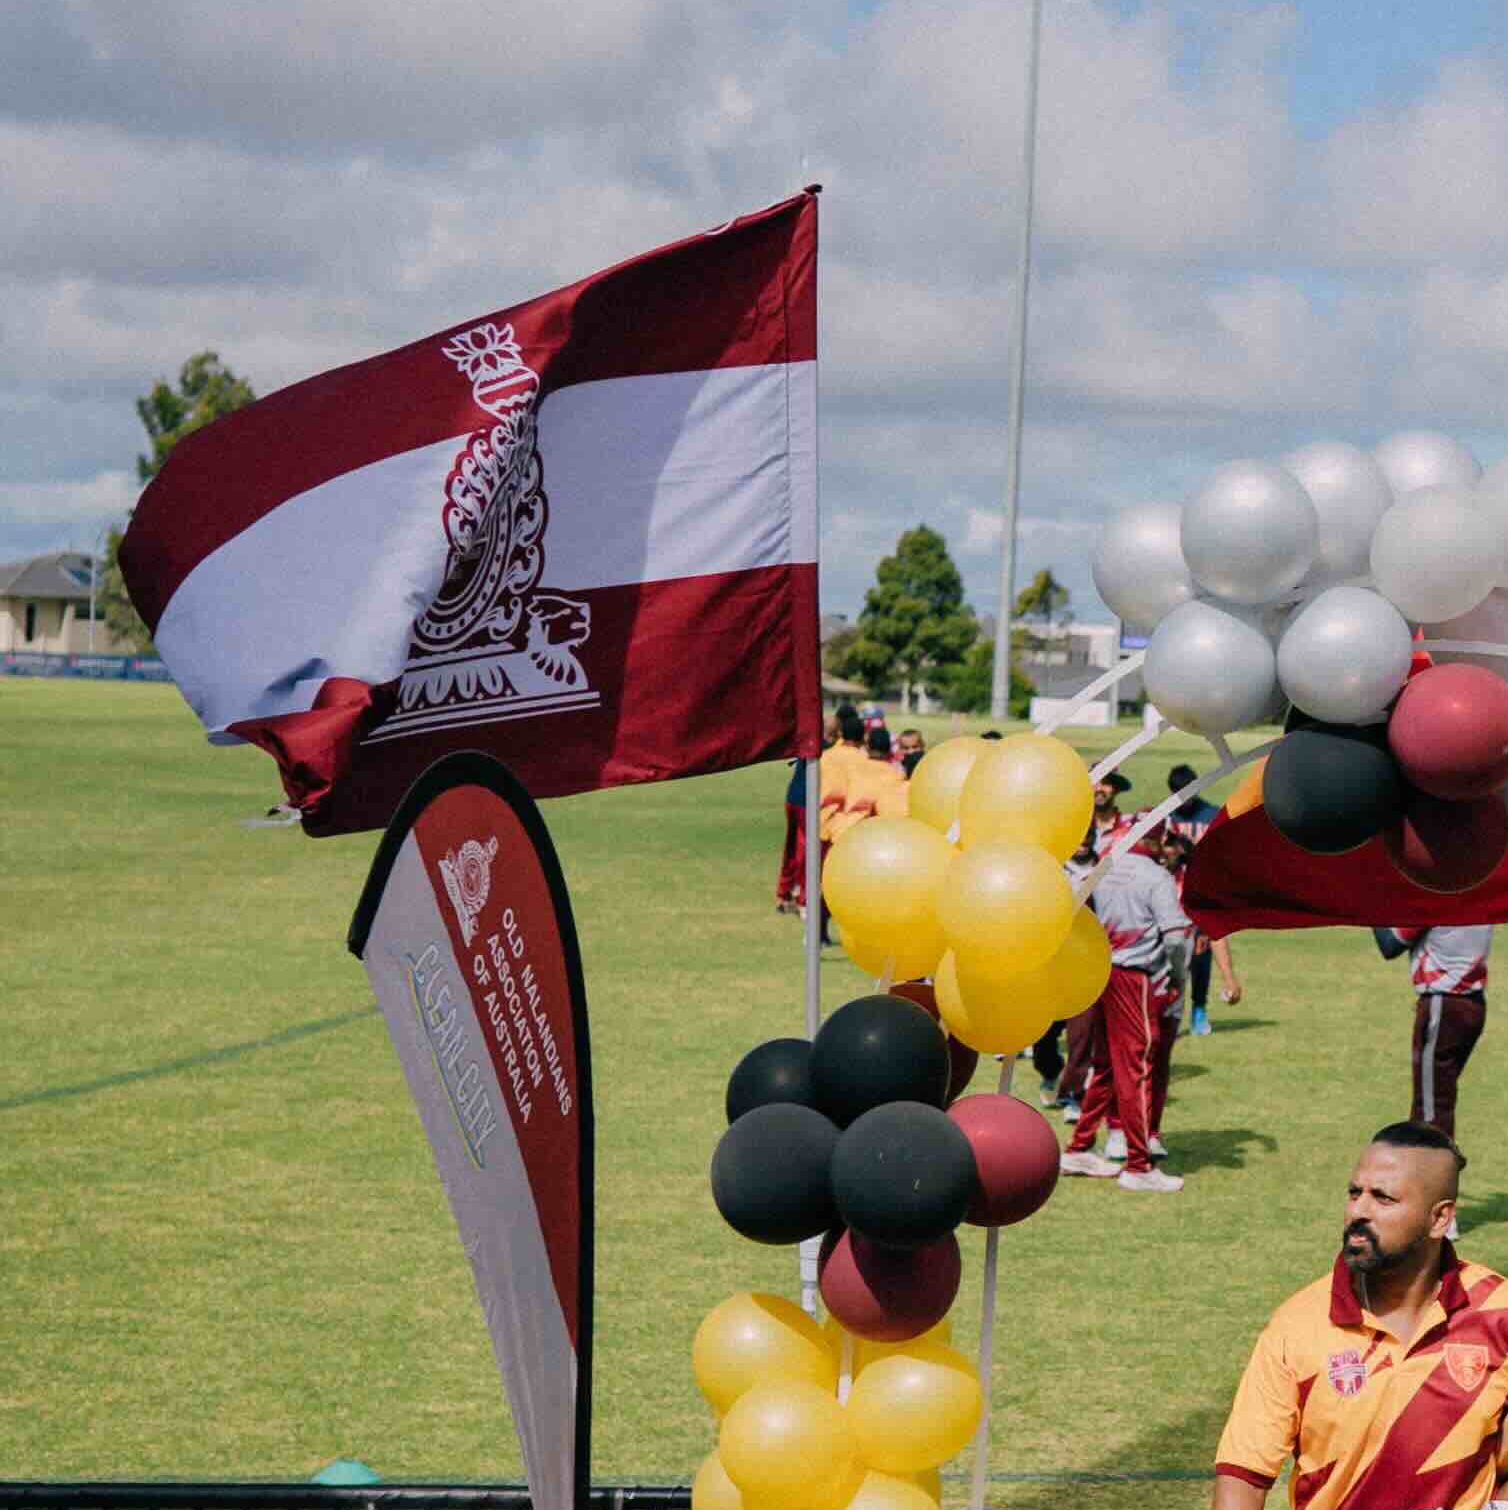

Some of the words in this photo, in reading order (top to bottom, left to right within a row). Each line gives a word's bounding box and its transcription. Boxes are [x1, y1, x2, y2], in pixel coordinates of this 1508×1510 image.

[473, 954, 490, 986] OF
[483, 992, 534, 1124] AUSTRALIA
[487, 933, 543, 1089] ASSOCIATION
[503, 907, 524, 959] OLD
[520, 963, 572, 1116] NALANDIANS
